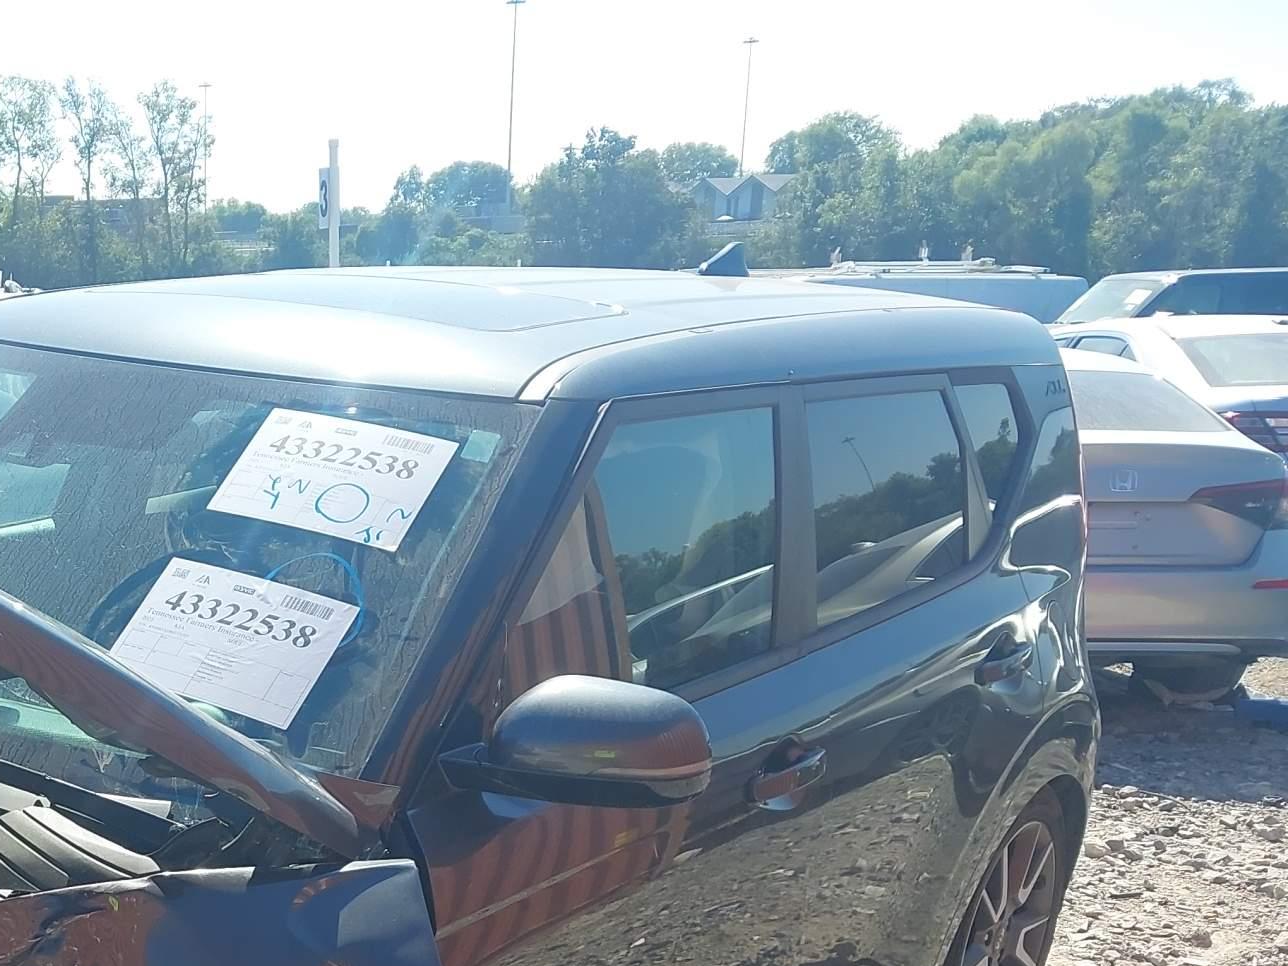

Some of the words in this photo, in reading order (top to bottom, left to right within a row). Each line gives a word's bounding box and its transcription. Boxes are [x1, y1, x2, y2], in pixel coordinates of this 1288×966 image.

[319, 179, 328, 218] 3
[269, 434, 419, 480] 43322538
[165, 590, 317, 648] 43322538
